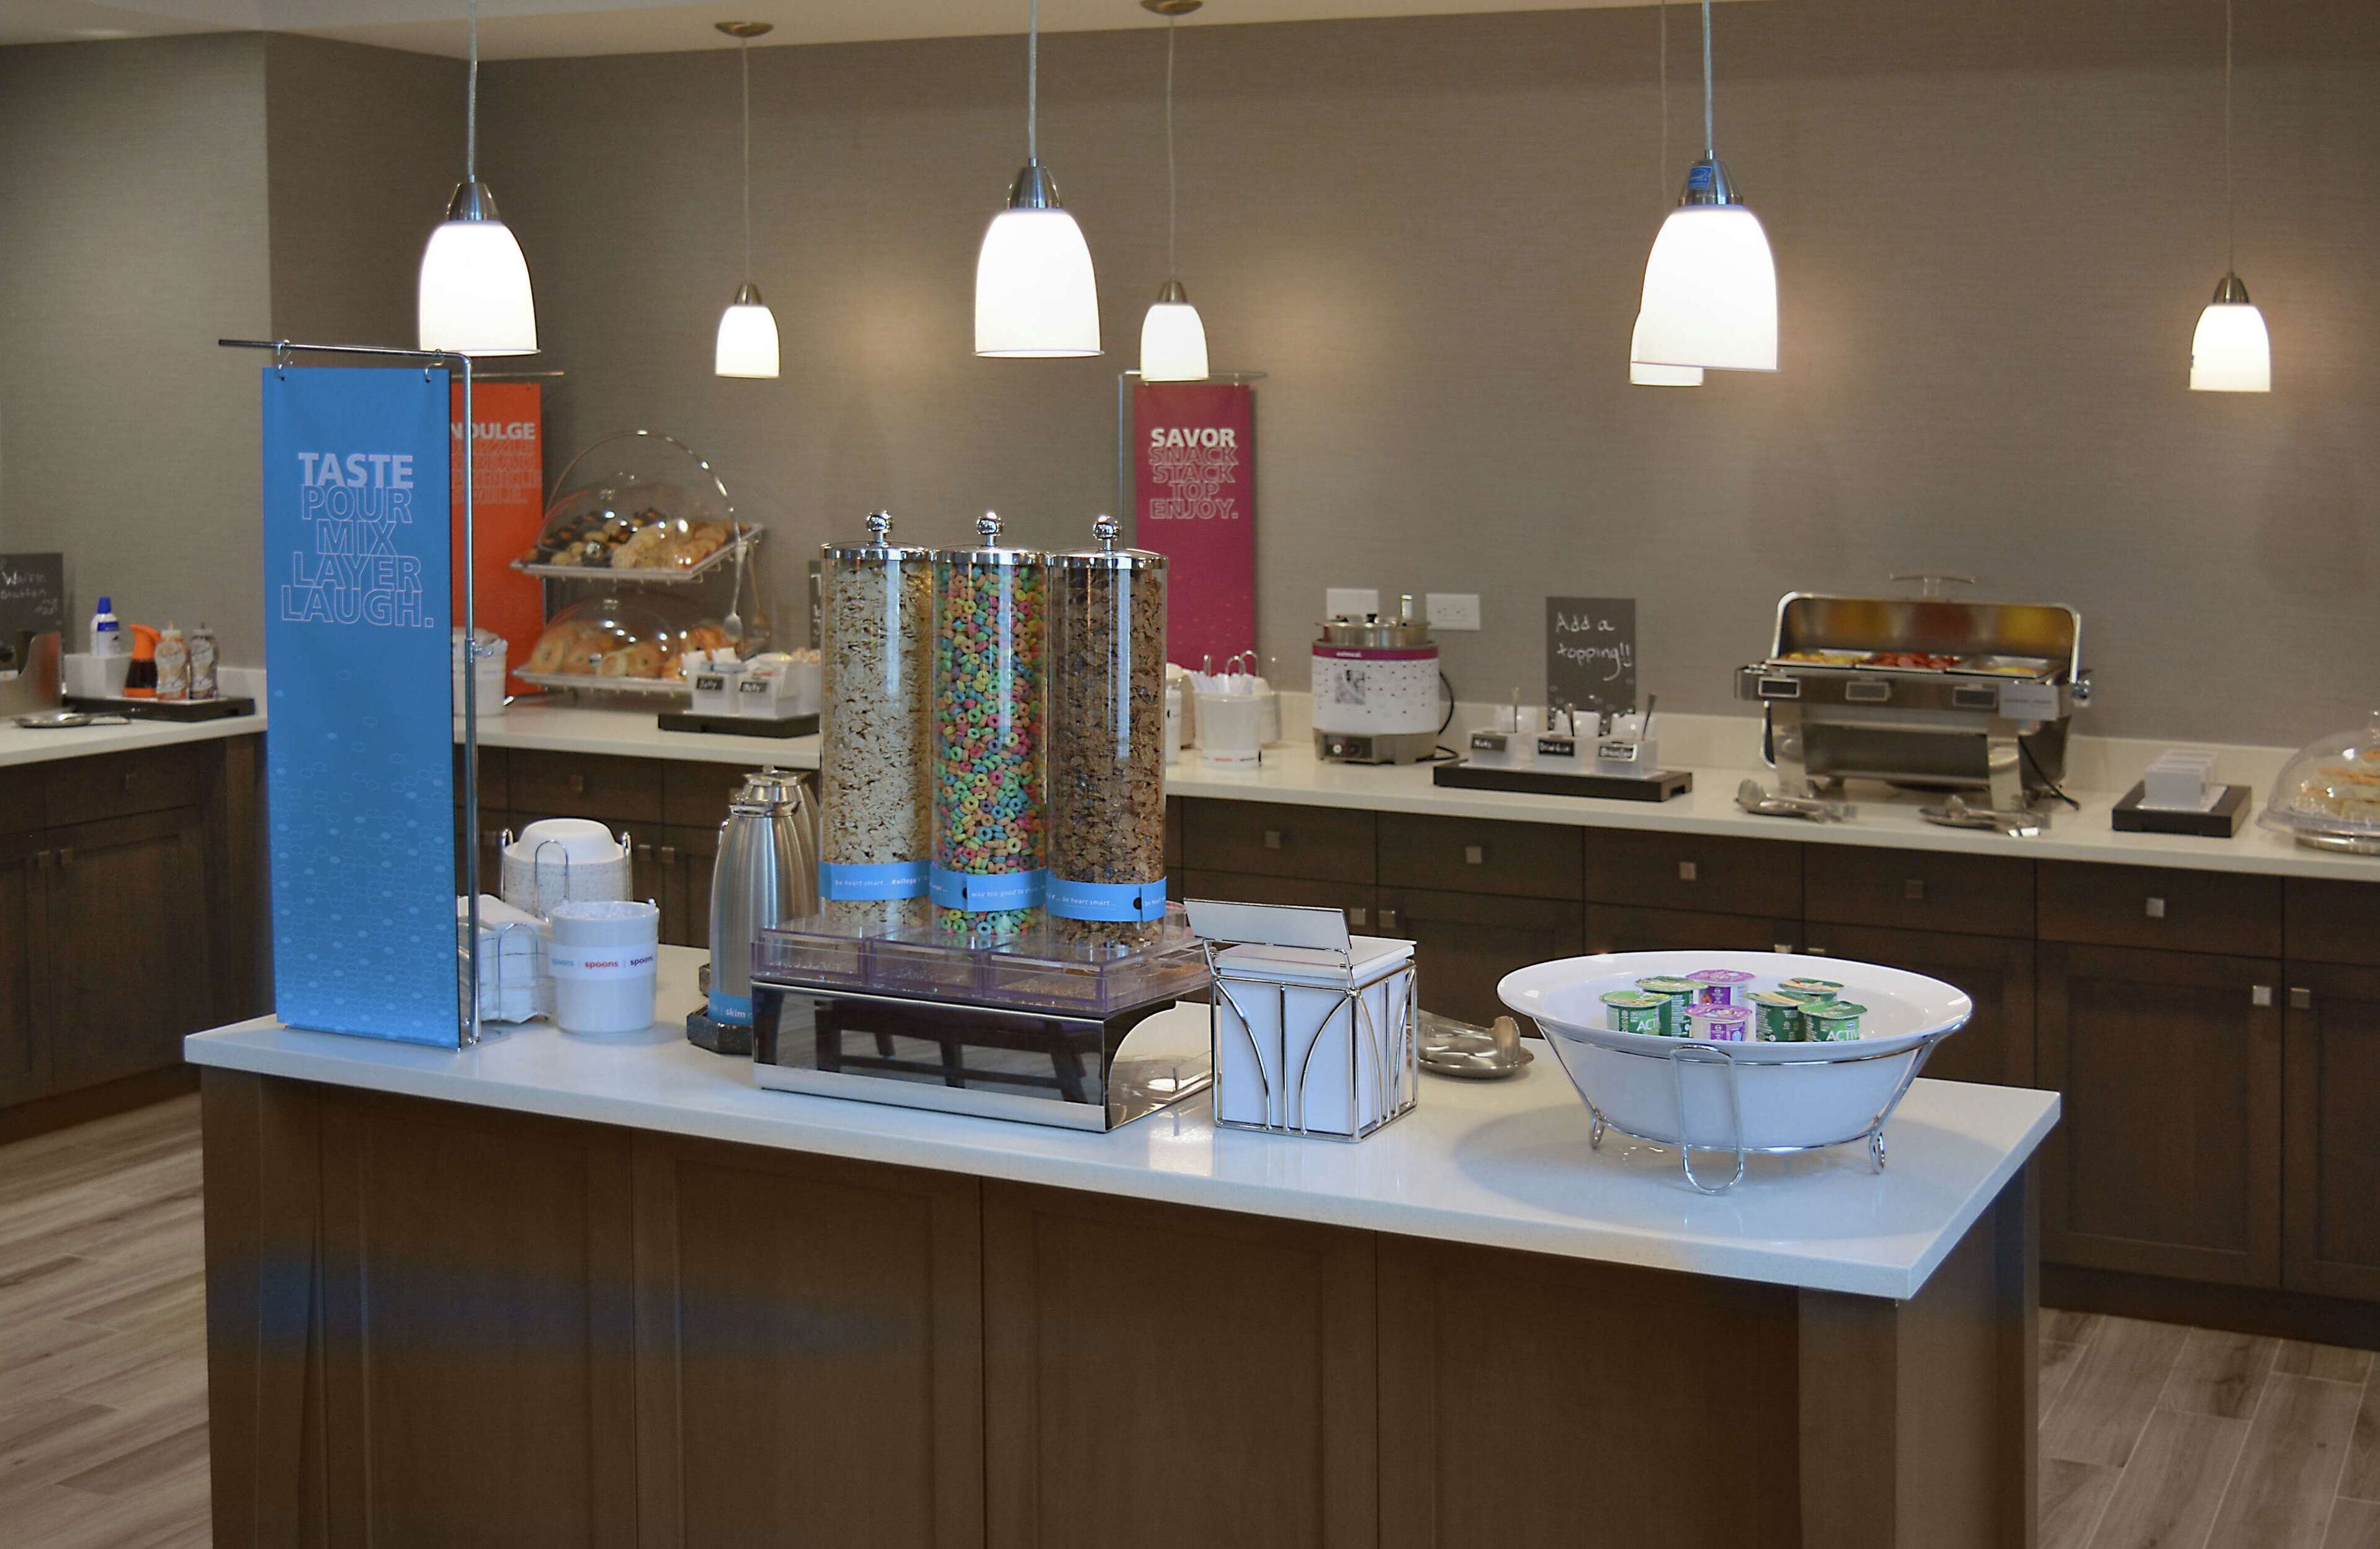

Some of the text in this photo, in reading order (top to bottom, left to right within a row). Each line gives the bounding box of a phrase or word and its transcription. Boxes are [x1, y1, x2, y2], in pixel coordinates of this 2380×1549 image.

[1151, 428, 1235, 447] SAVOR
[1149, 447, 1238, 465] SNACK
[298, 453, 414, 488] TASTE
[1152, 465, 1235, 483] STACK
[1168, 483, 1219, 501] TOP
[302, 485, 413, 523] POUR
[1150, 499, 1239, 519] ENJOY.
[317, 519, 398, 556] MIX
[293, 551, 423, 592] LAYER
[281, 586, 434, 628] LAUGH.
[1555, 612, 1616, 633] Add a
[585, 961, 619, 969] spoons
